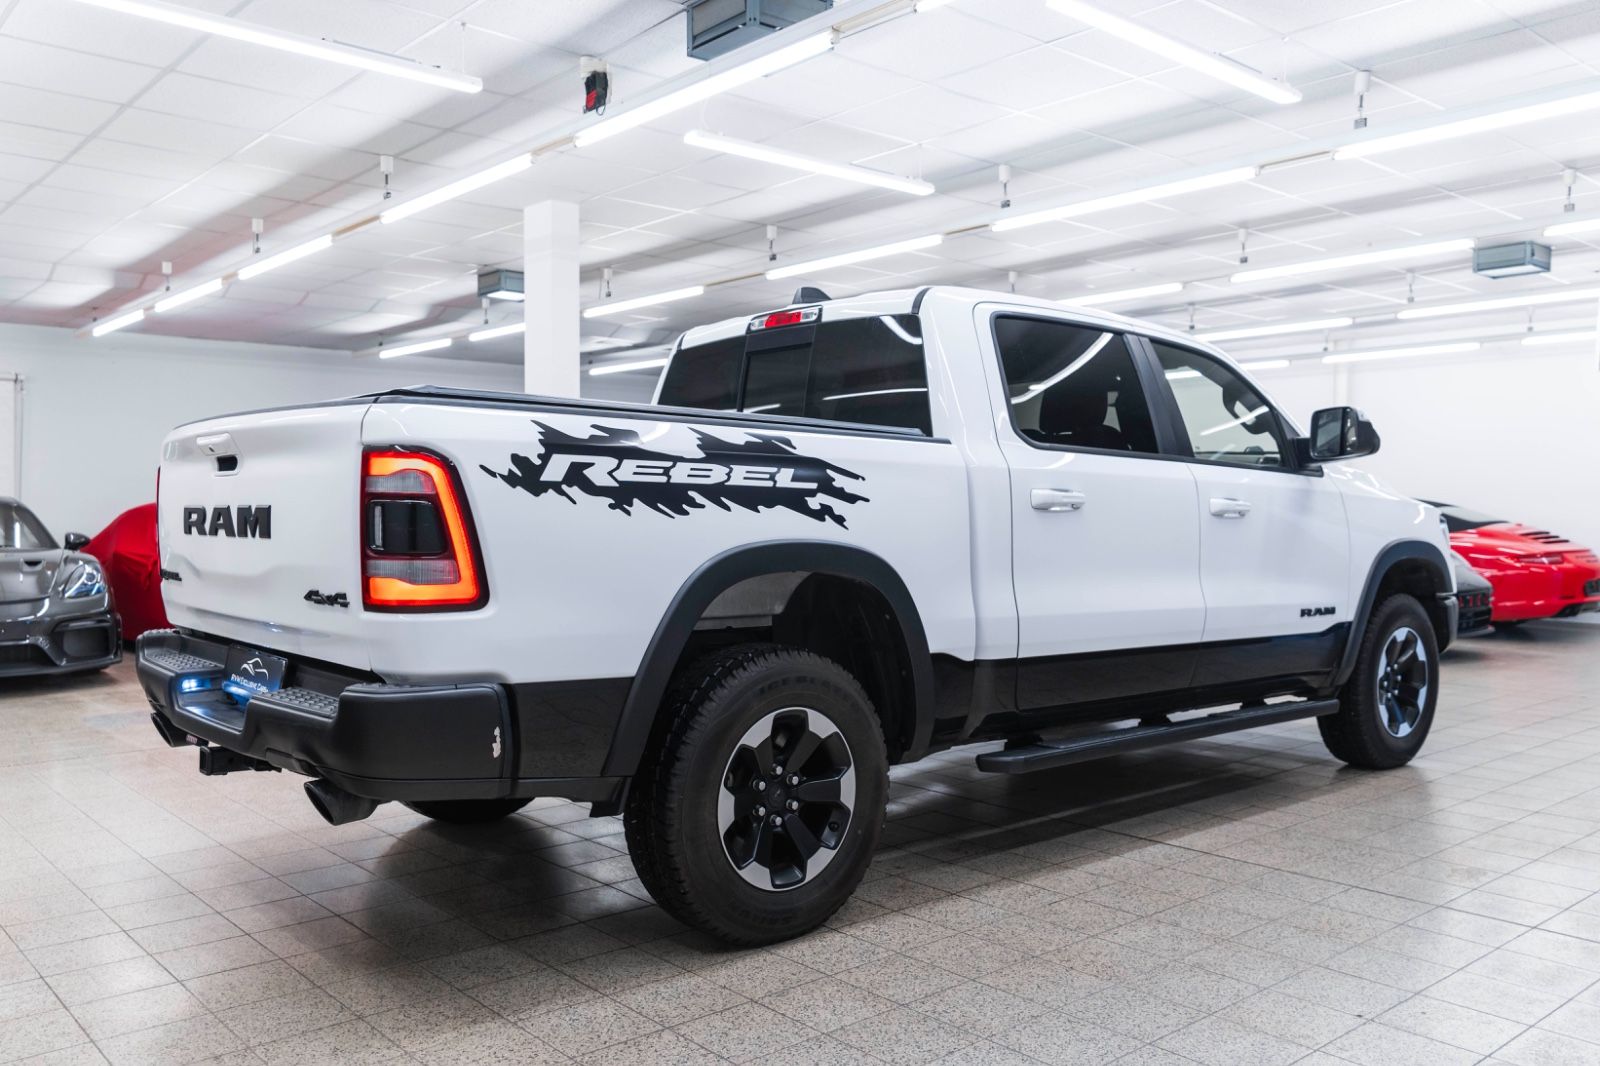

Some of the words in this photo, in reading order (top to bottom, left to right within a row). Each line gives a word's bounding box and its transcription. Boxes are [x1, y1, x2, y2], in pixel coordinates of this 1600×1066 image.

[539, 453, 818, 489] REBEL
[183, 504, 272, 539] RAM
[1300, 606, 1336, 617] RAM
